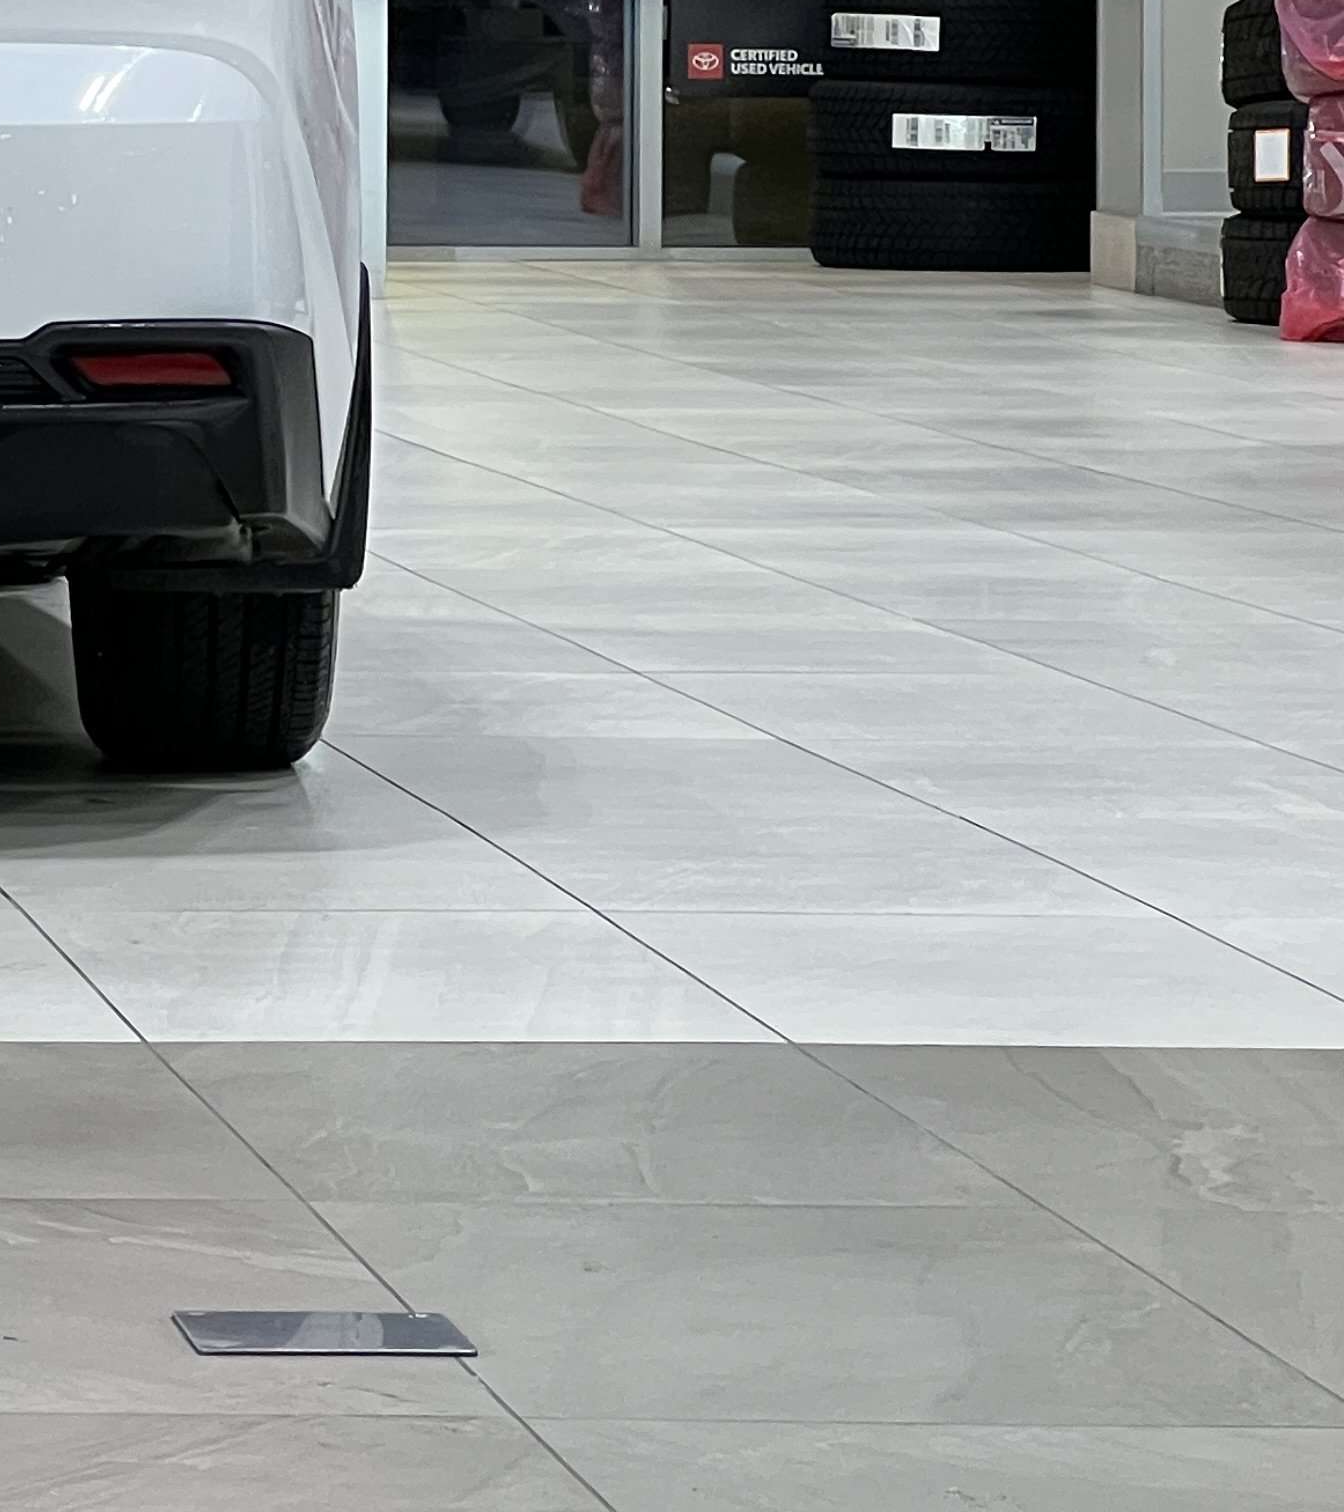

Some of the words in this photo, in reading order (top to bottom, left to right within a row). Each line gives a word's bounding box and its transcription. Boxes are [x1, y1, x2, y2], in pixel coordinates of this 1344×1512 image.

[730, 49, 799, 62] CERTIFIED
[730, 63, 767, 75] USED
[768, 63, 824, 76] VEHICLE
